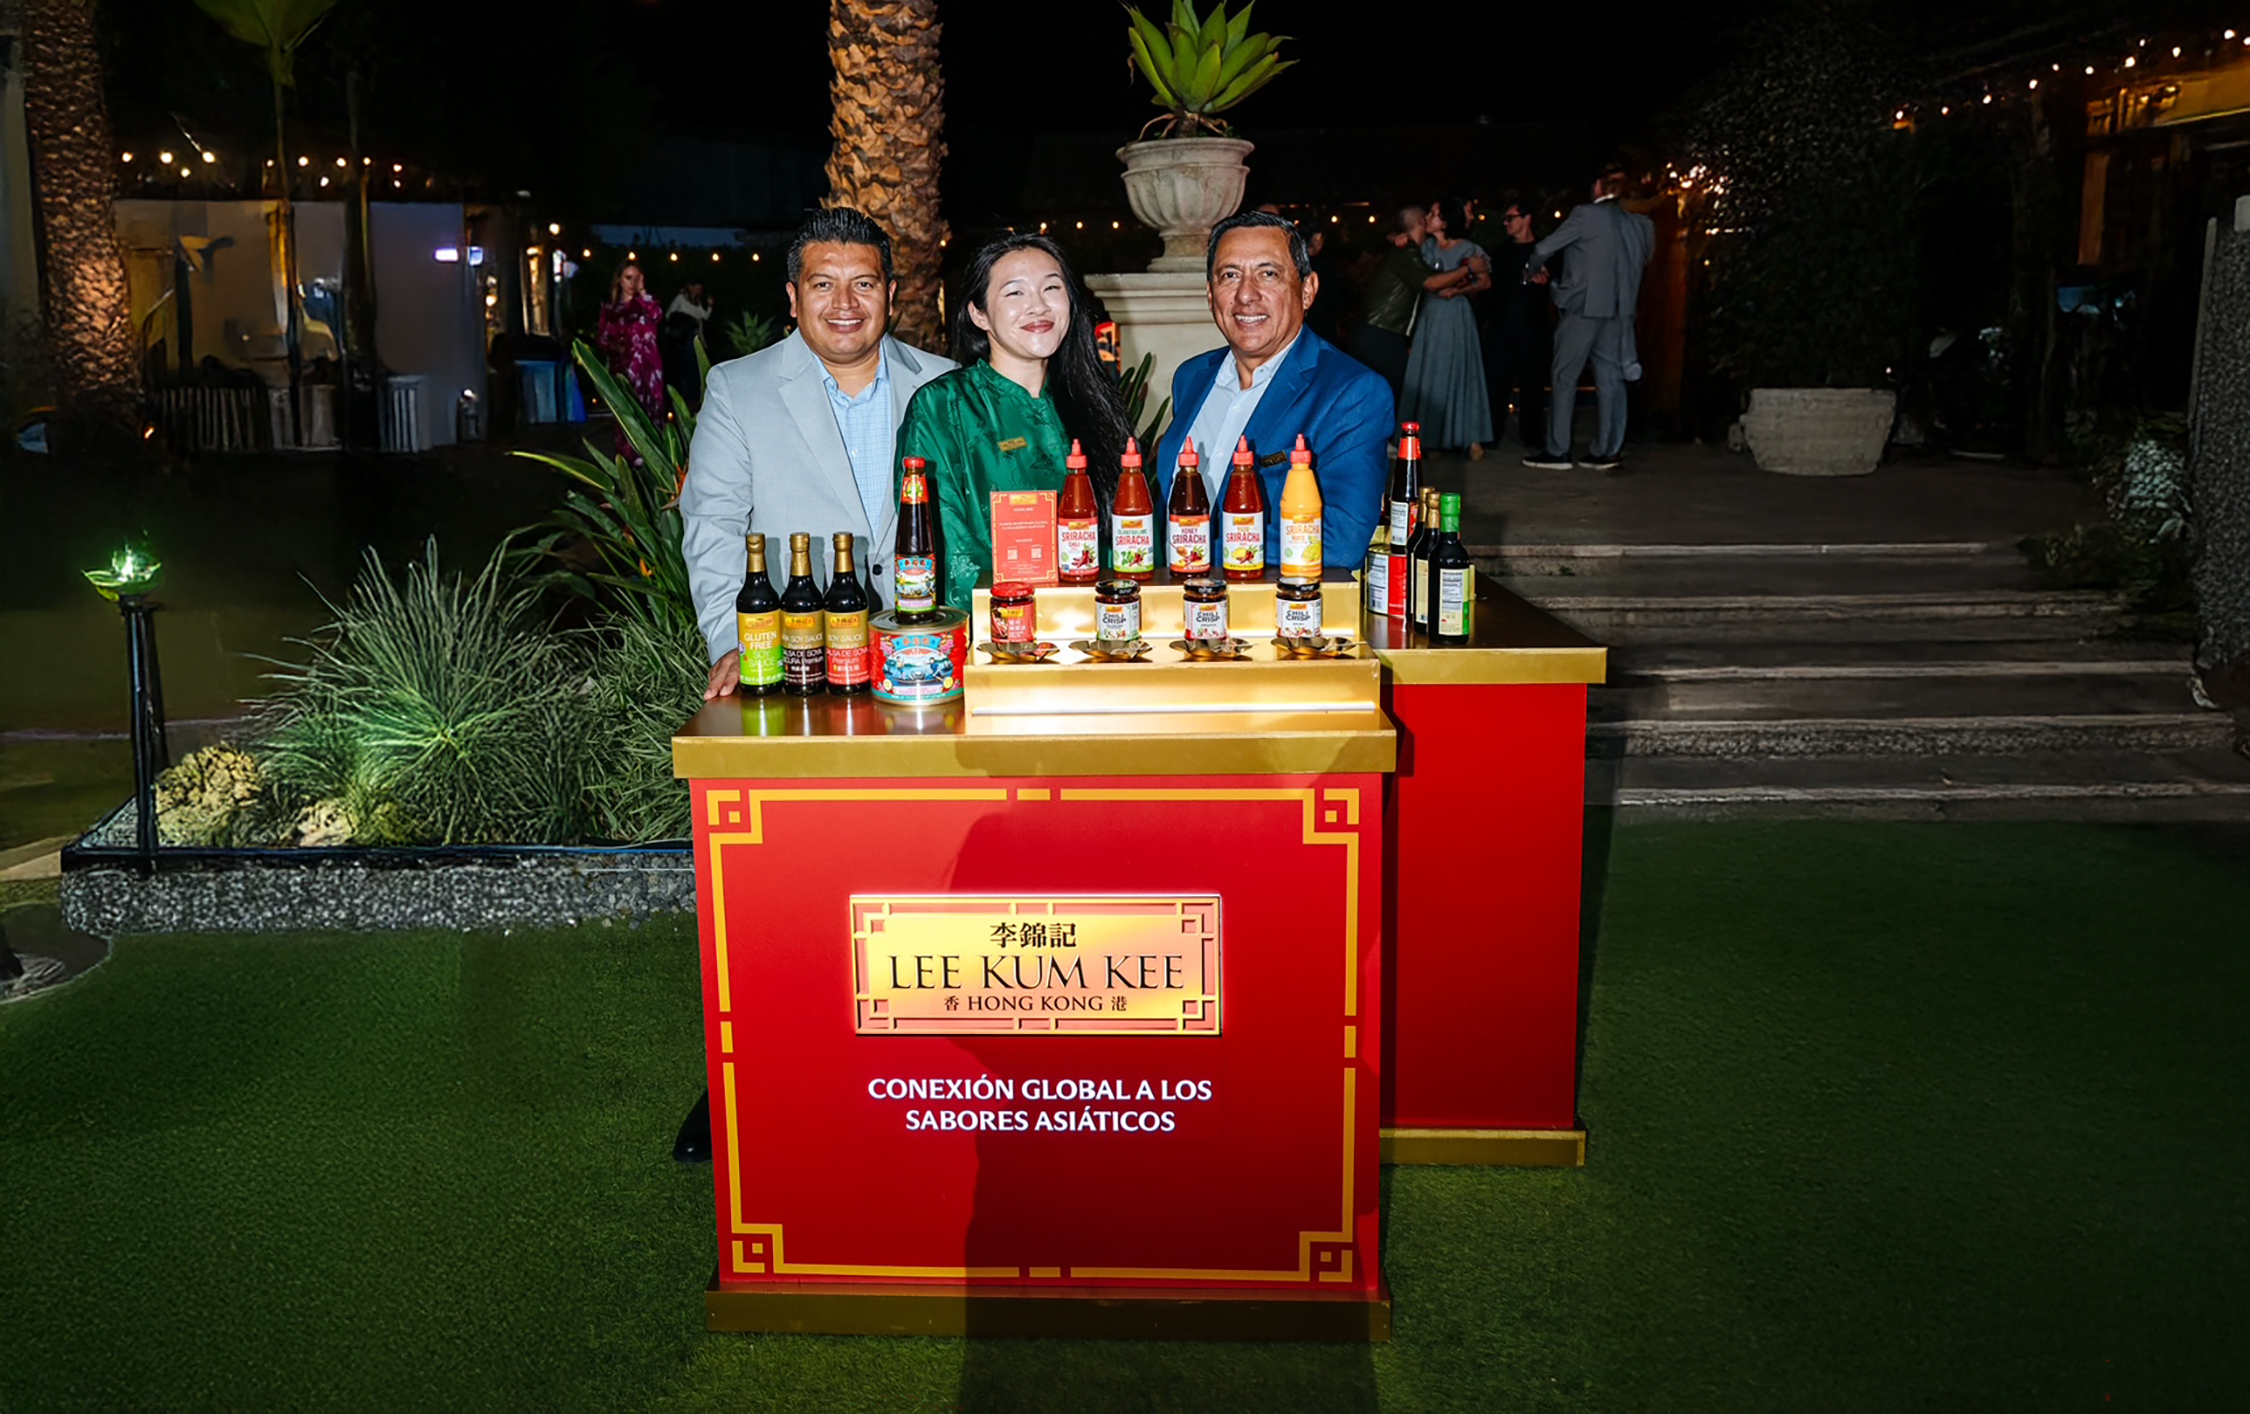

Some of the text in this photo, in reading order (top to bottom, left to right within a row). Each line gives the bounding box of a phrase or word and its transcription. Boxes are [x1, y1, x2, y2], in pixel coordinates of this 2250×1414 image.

[1285, 525, 1320, 535] SRIRACHA
[1062, 531, 1096, 542] SRIRACHA
[1115, 535, 1150, 546] SRIRACHA
[1172, 534, 1206, 544] SRIRACHA
[1226, 532, 1260, 543] SRIRACHA
[1102, 616, 1127, 624] CRISP
[1285, 614, 1311, 622] CRISP
[744, 631, 777, 642] GLUTEN
[791, 635, 804, 643] SOY
[805, 633, 823, 642] SAUCE
[841, 633, 864, 642] SAUCE
[750, 641, 773, 649] FREE
[753, 650, 770, 658] SOY
[853, 647, 868, 656] SOYA
[748, 657, 775, 667] SAUCE
[990, 922, 1077, 948] 李錦記
[889, 955, 1185, 989] LEE KUM KEE
[944, 995, 1127, 1011] 香 HONG KONG 港
[868, 1074, 1212, 1100] CONEXIÓN GLOBAL A LOS
[905, 1106, 1176, 1132] SABORES ASIÁTICOS
